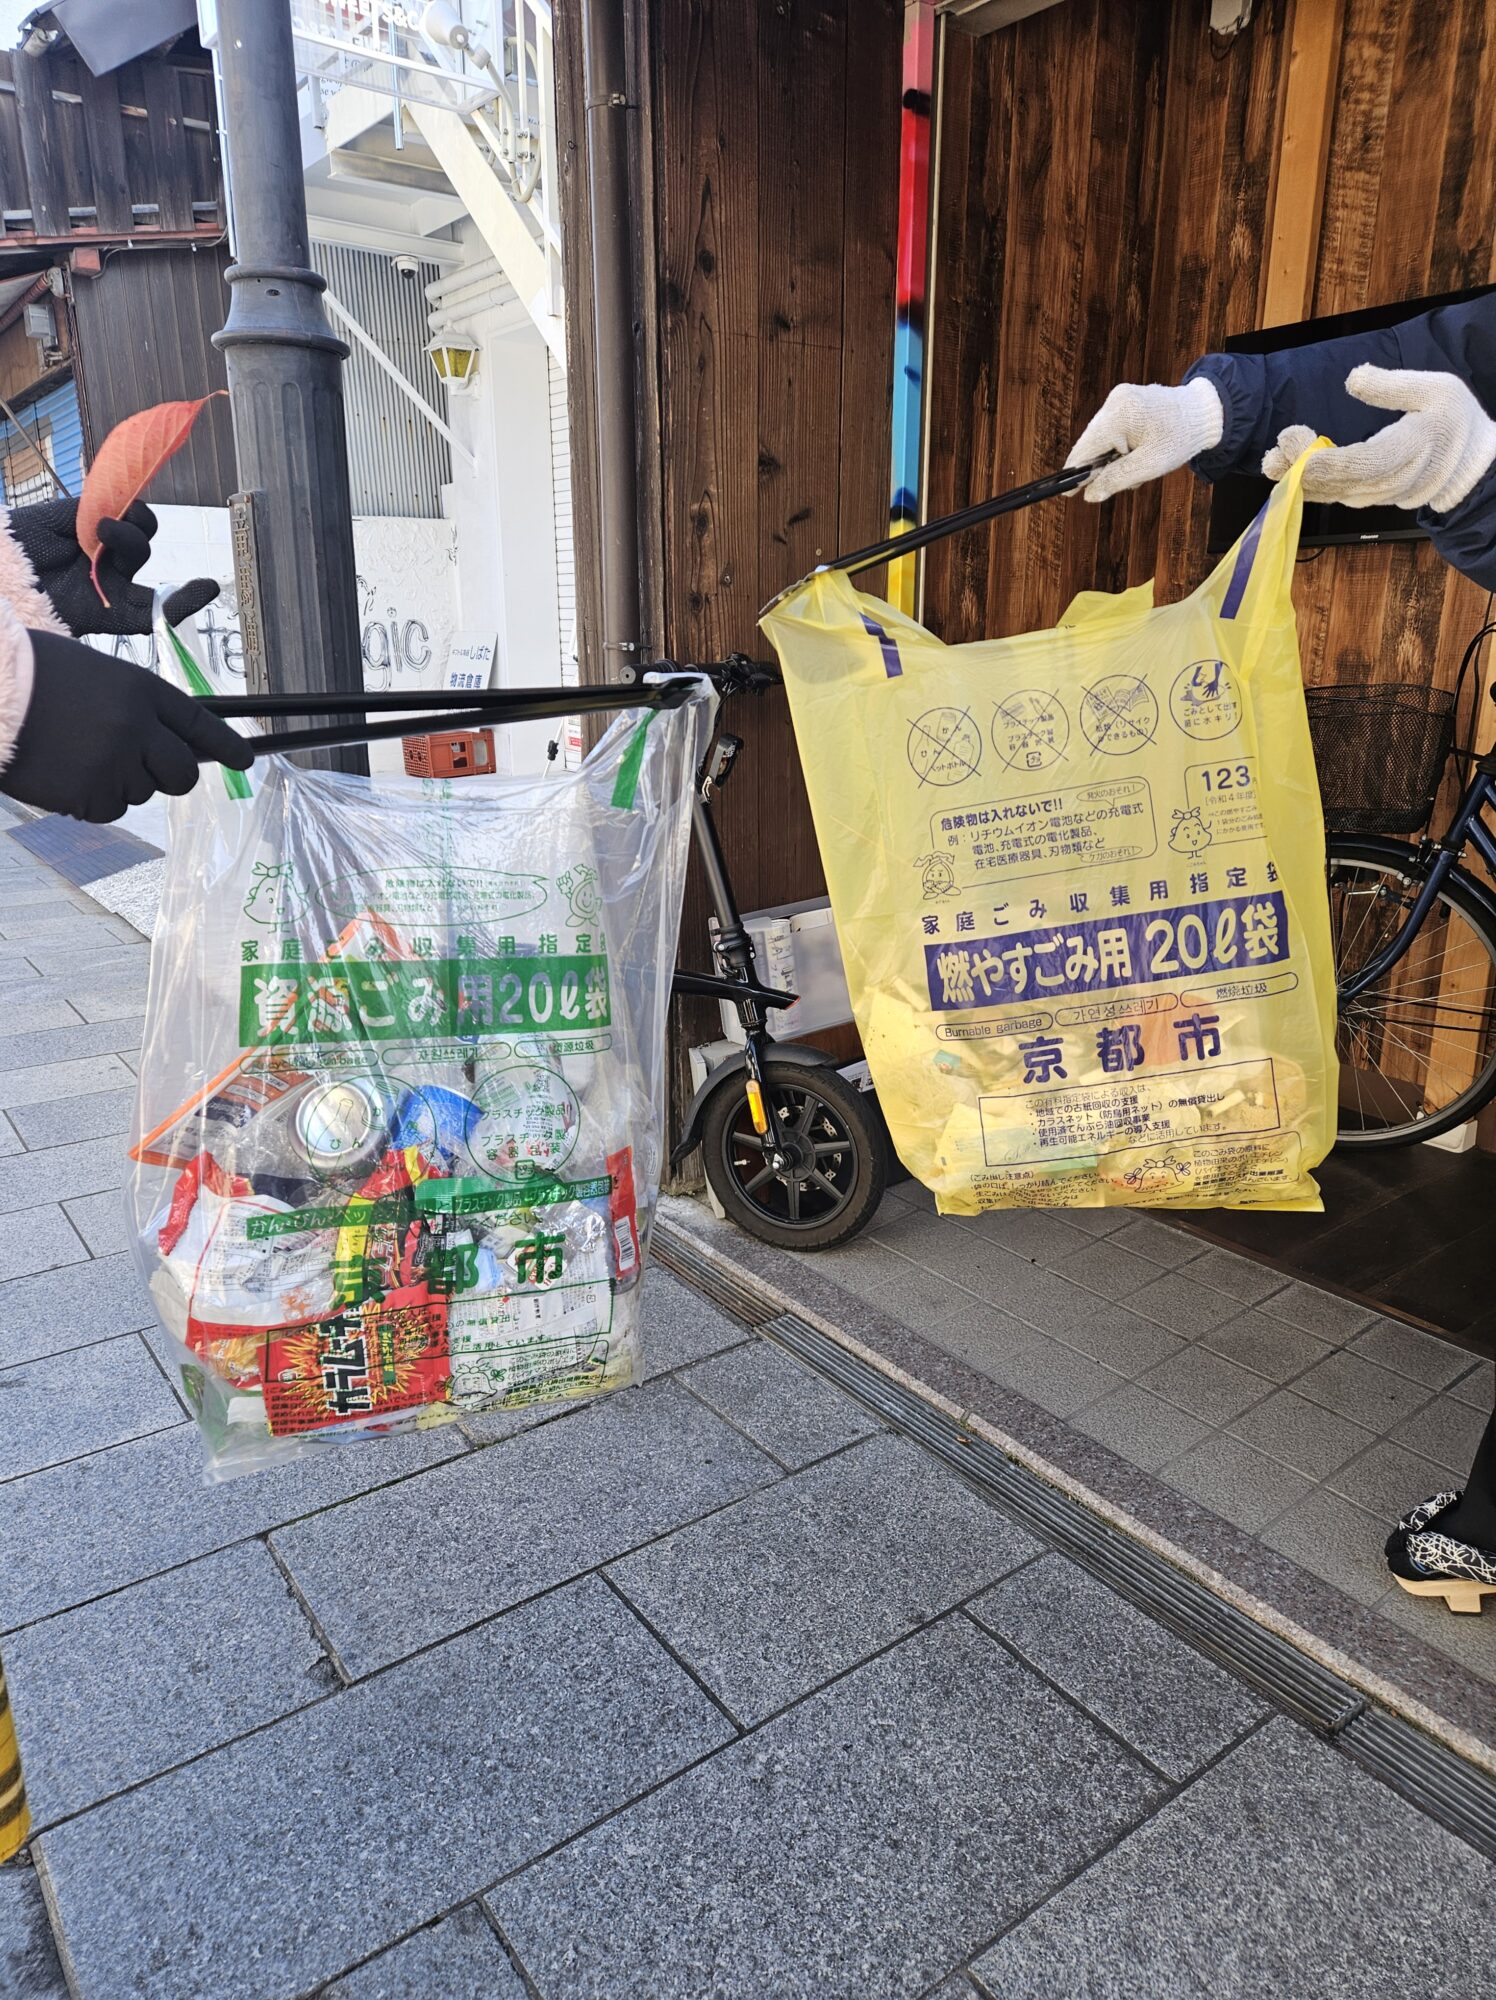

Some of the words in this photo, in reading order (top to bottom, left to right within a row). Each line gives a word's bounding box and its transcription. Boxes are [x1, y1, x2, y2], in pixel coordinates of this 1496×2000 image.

[470, 645, 491, 661] しばた
[450, 672, 483, 689] 物流倉庫
[972, 826, 1098, 856] 電池、充電式の電化製品、
[974, 837, 1106, 870] 在宅医療器具、刃物類など
[921, 861, 1280, 935] 家庭ごみ収集用指定袋
[945, 1022, 991, 1038] Burnable
[996, 1016, 1043, 1035] garbage
[1018, 1013, 1224, 1085] 京都市
[329, 1231, 566, 1304] 京都市
